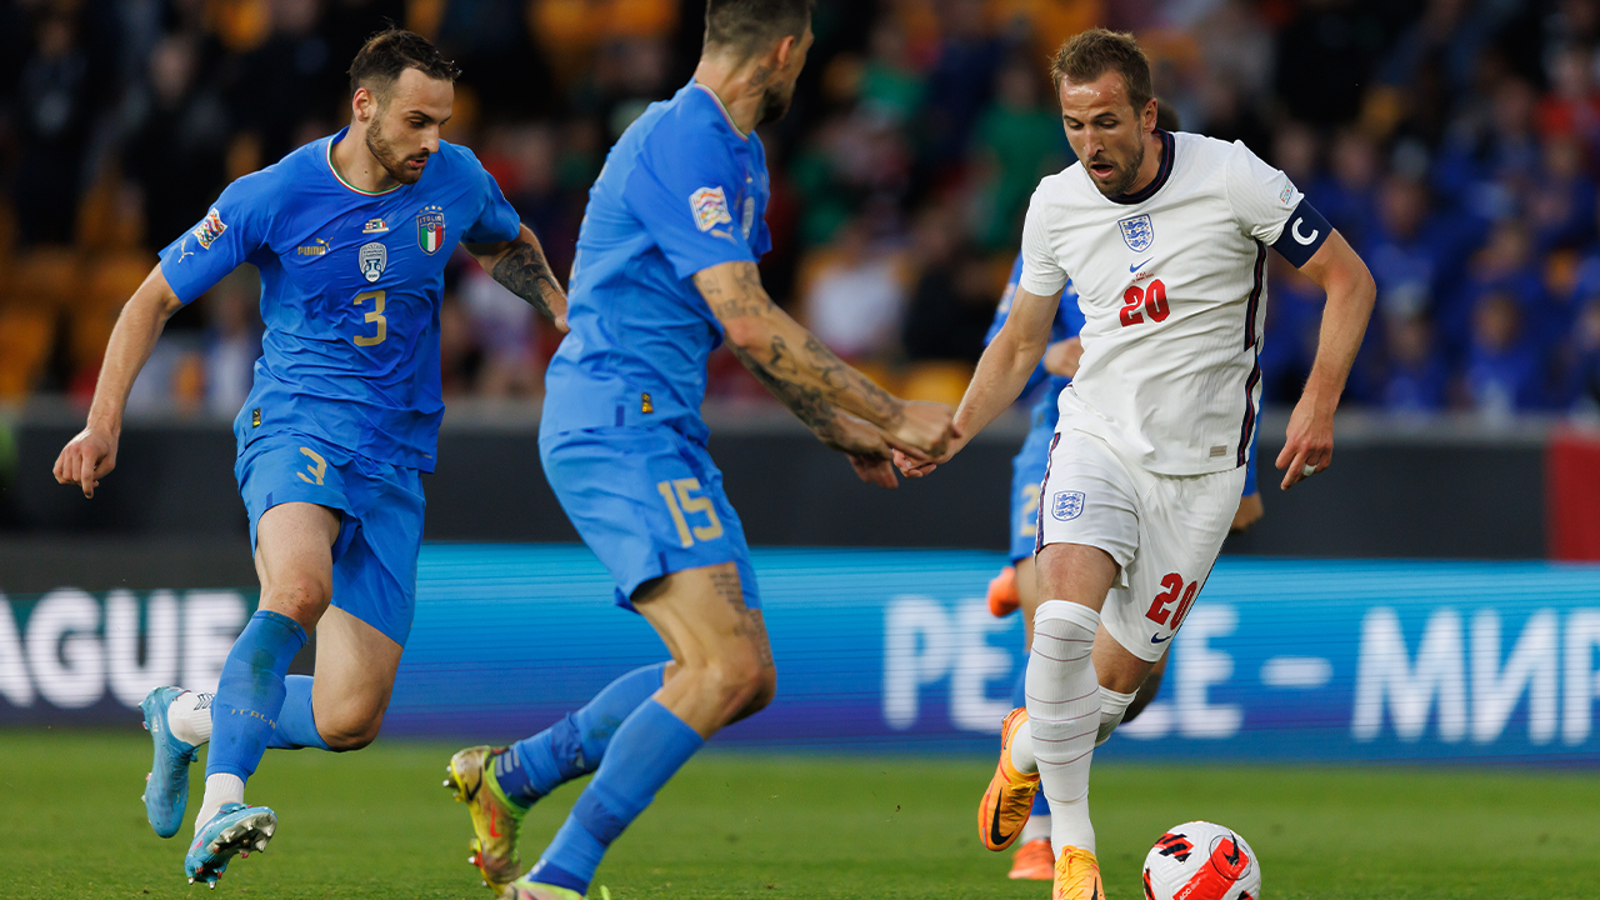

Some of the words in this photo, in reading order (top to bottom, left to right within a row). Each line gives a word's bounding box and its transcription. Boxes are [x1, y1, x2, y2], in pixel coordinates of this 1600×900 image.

[297, 245, 326, 256] PUMA
[1291, 216, 1319, 246] C
[353, 289, 387, 347] 3
[1119, 278, 1170, 327] 20
[296, 446, 327, 486] 3
[657, 477, 723, 548] 15
[1145, 572, 1198, 630] 20
[231, 708, 276, 730] ITALIA
